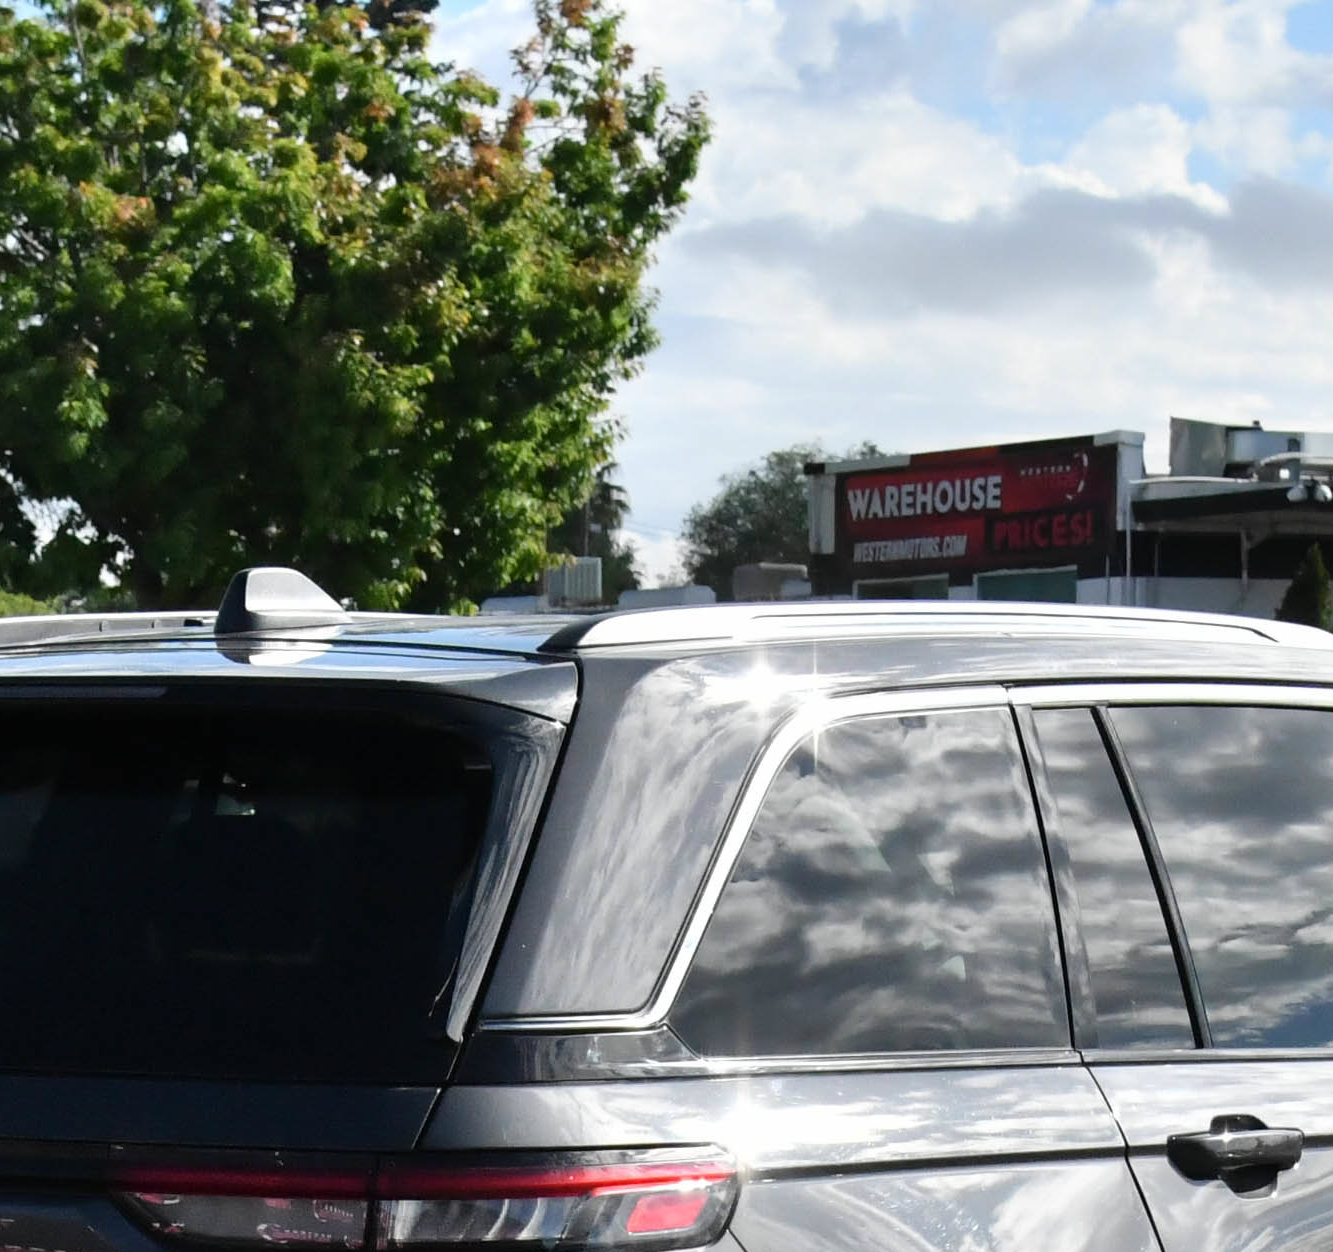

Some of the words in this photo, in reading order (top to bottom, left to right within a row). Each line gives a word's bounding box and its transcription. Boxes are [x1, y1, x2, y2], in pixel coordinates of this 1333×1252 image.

[847, 474, 1002, 521] WAREHOUSE
[853, 534, 967, 563] WESTERNMOTORS.COM
[992, 514, 1094, 552] PRICES!
